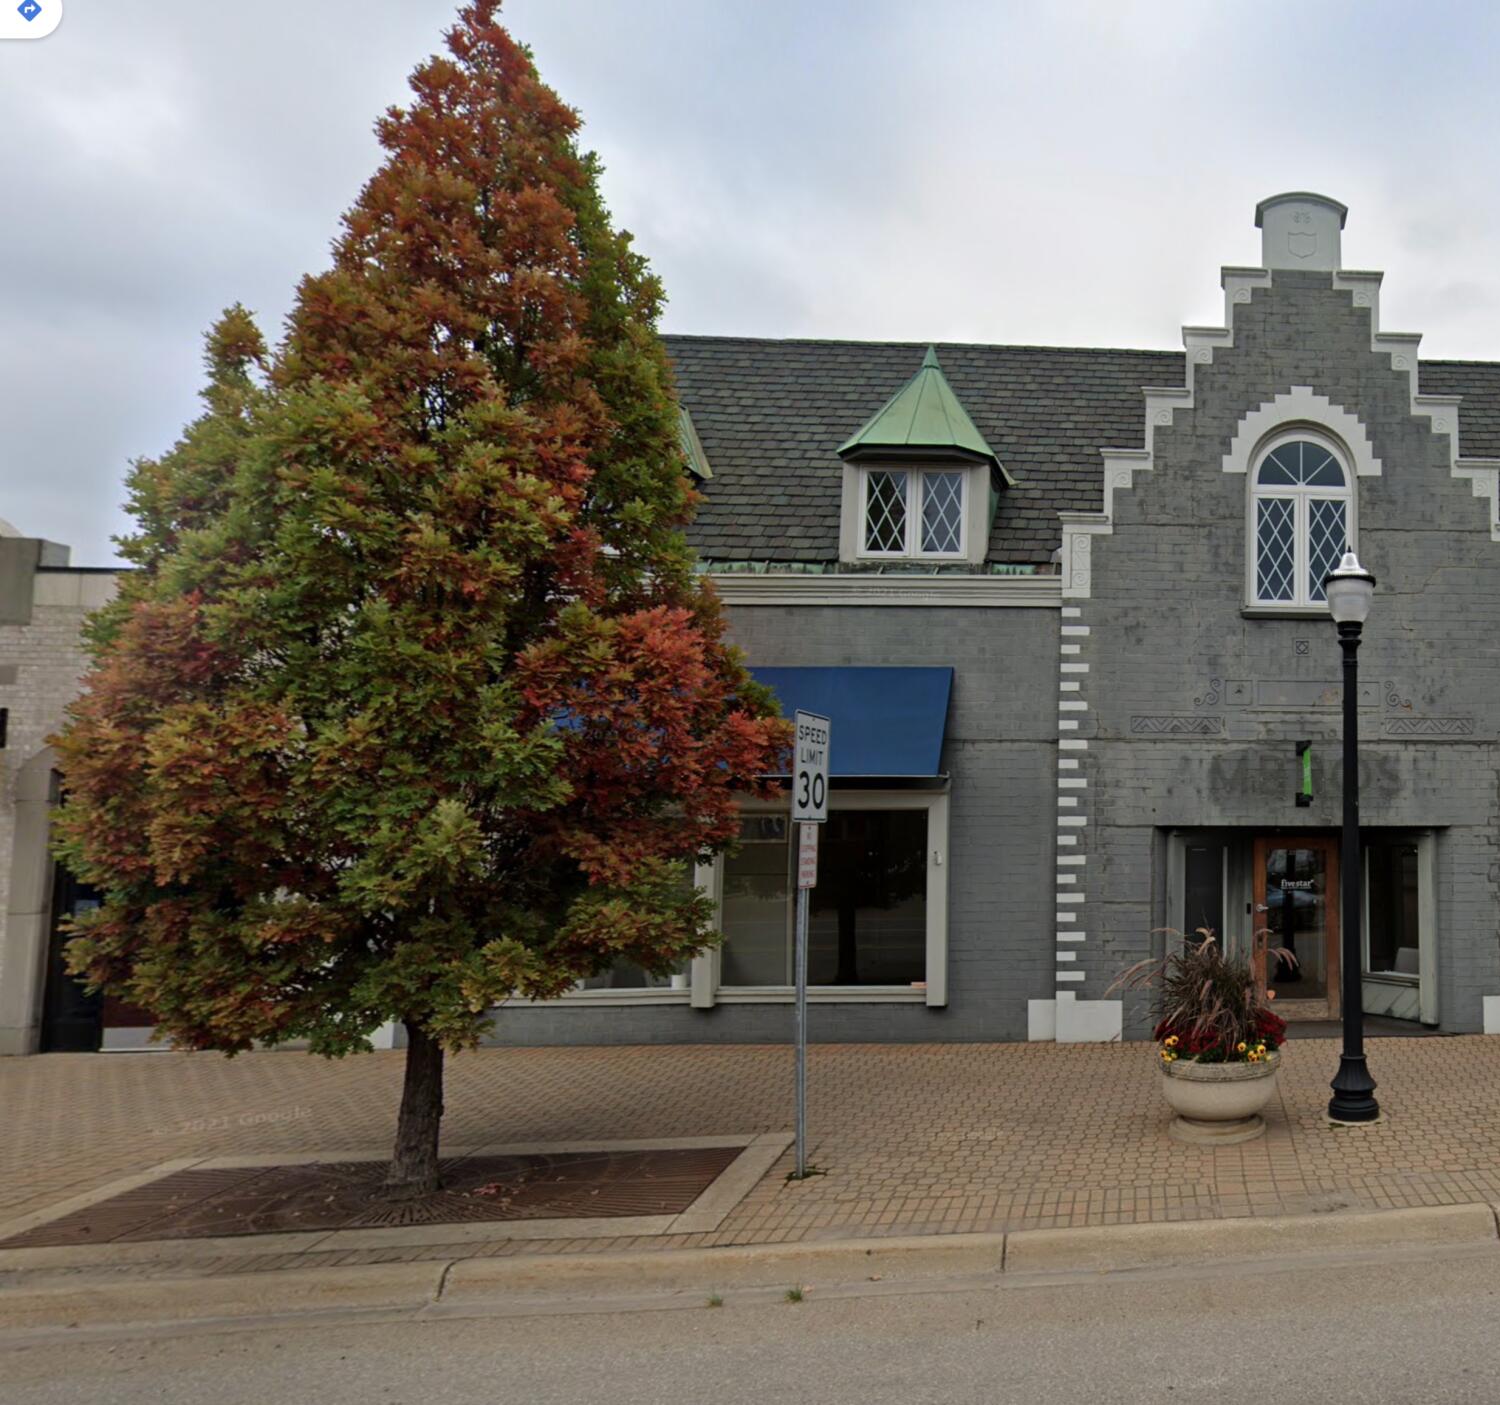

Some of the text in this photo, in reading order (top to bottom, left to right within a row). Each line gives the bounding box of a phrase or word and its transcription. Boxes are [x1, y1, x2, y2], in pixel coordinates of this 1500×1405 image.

[799, 725, 827, 745] SPEED
[801, 747, 823, 766] LIMIT
[798, 771, 825, 809] 30
